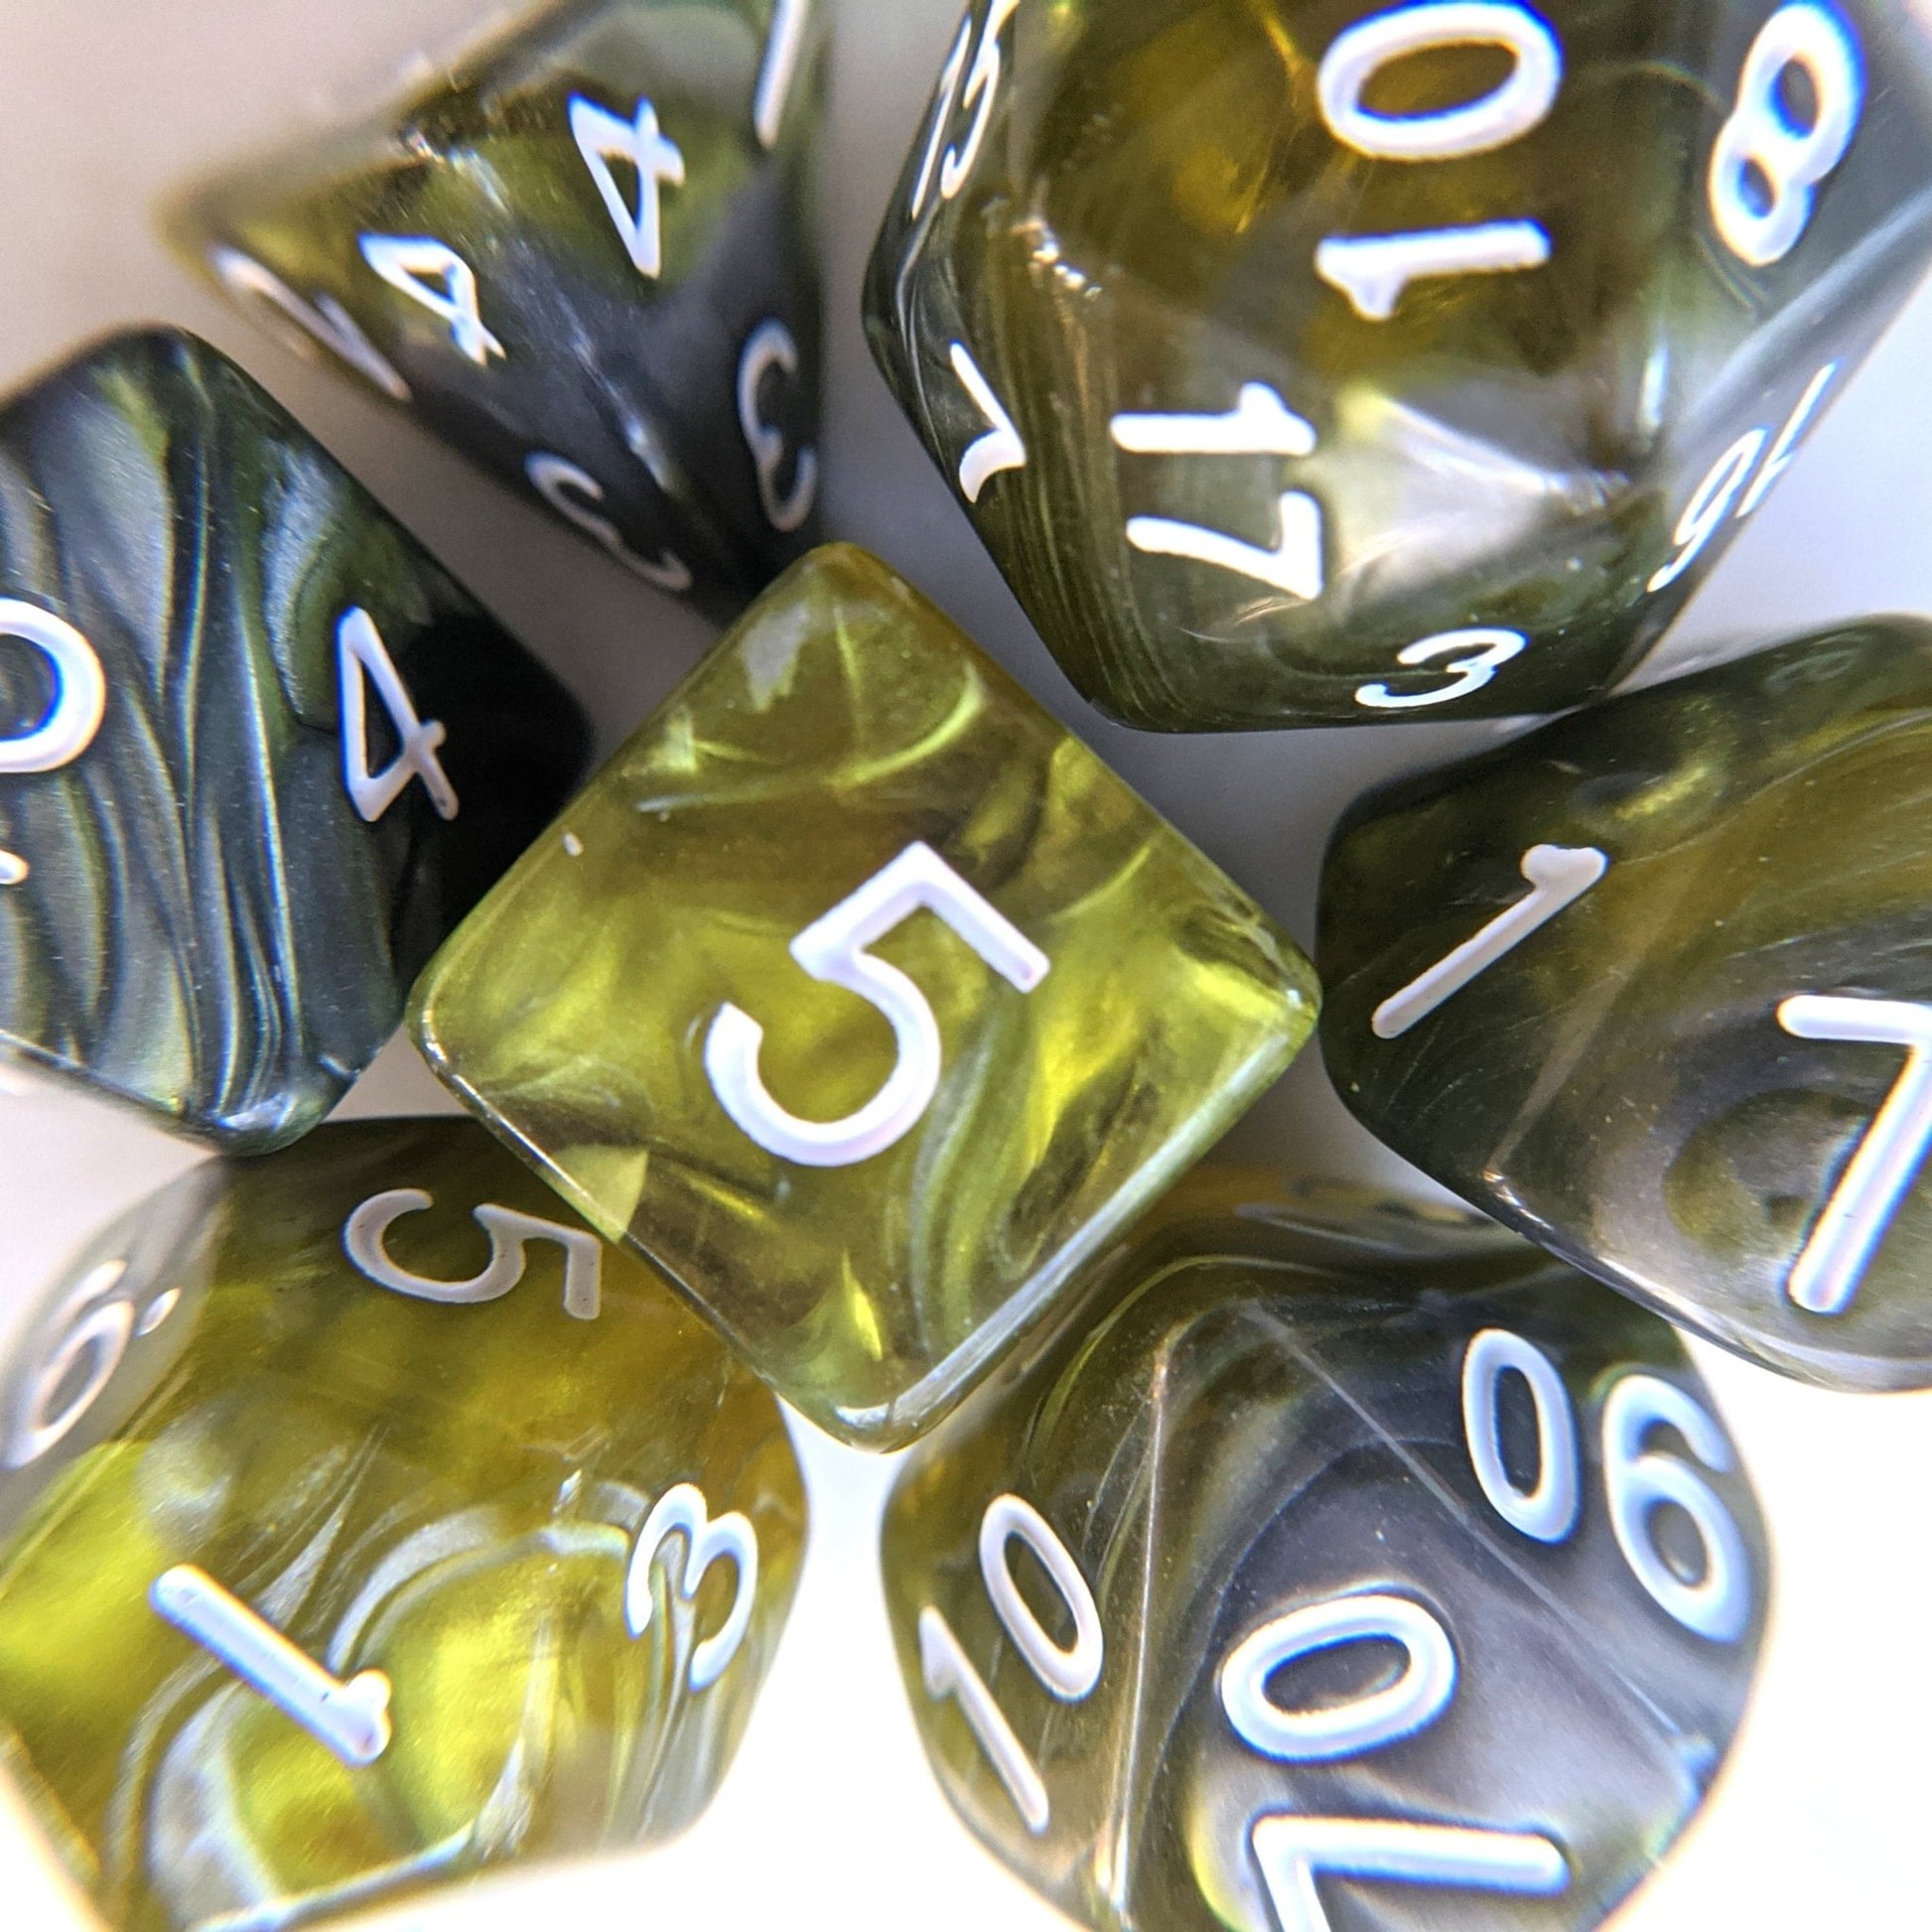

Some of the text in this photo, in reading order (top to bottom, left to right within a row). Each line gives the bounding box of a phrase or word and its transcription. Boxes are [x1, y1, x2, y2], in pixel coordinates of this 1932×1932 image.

[568, 91, 687, 280] 4
[1315, 0, 1564, 321] 10
[1706, 0, 1868, 267] 8
[357, 232, 506, 368] 4
[737, 316, 818, 533] 3
[1109, 381, 1324, 601] 17
[336, 603, 459, 823] 4
[1354, 627, 1528, 709] 3
[703, 840, 1050, 1168] 5
[1371, 844, 1610, 1039] 1
[343, 1187, 604, 1320] 5
[1777, 994, 1932, 1315] 7
[149, 1563, 391, 1768] 1
[625, 1482, 759, 1694] 3
[917, 1492, 1104, 1834] 10
[1219, 1591, 1571, 1932] 70
